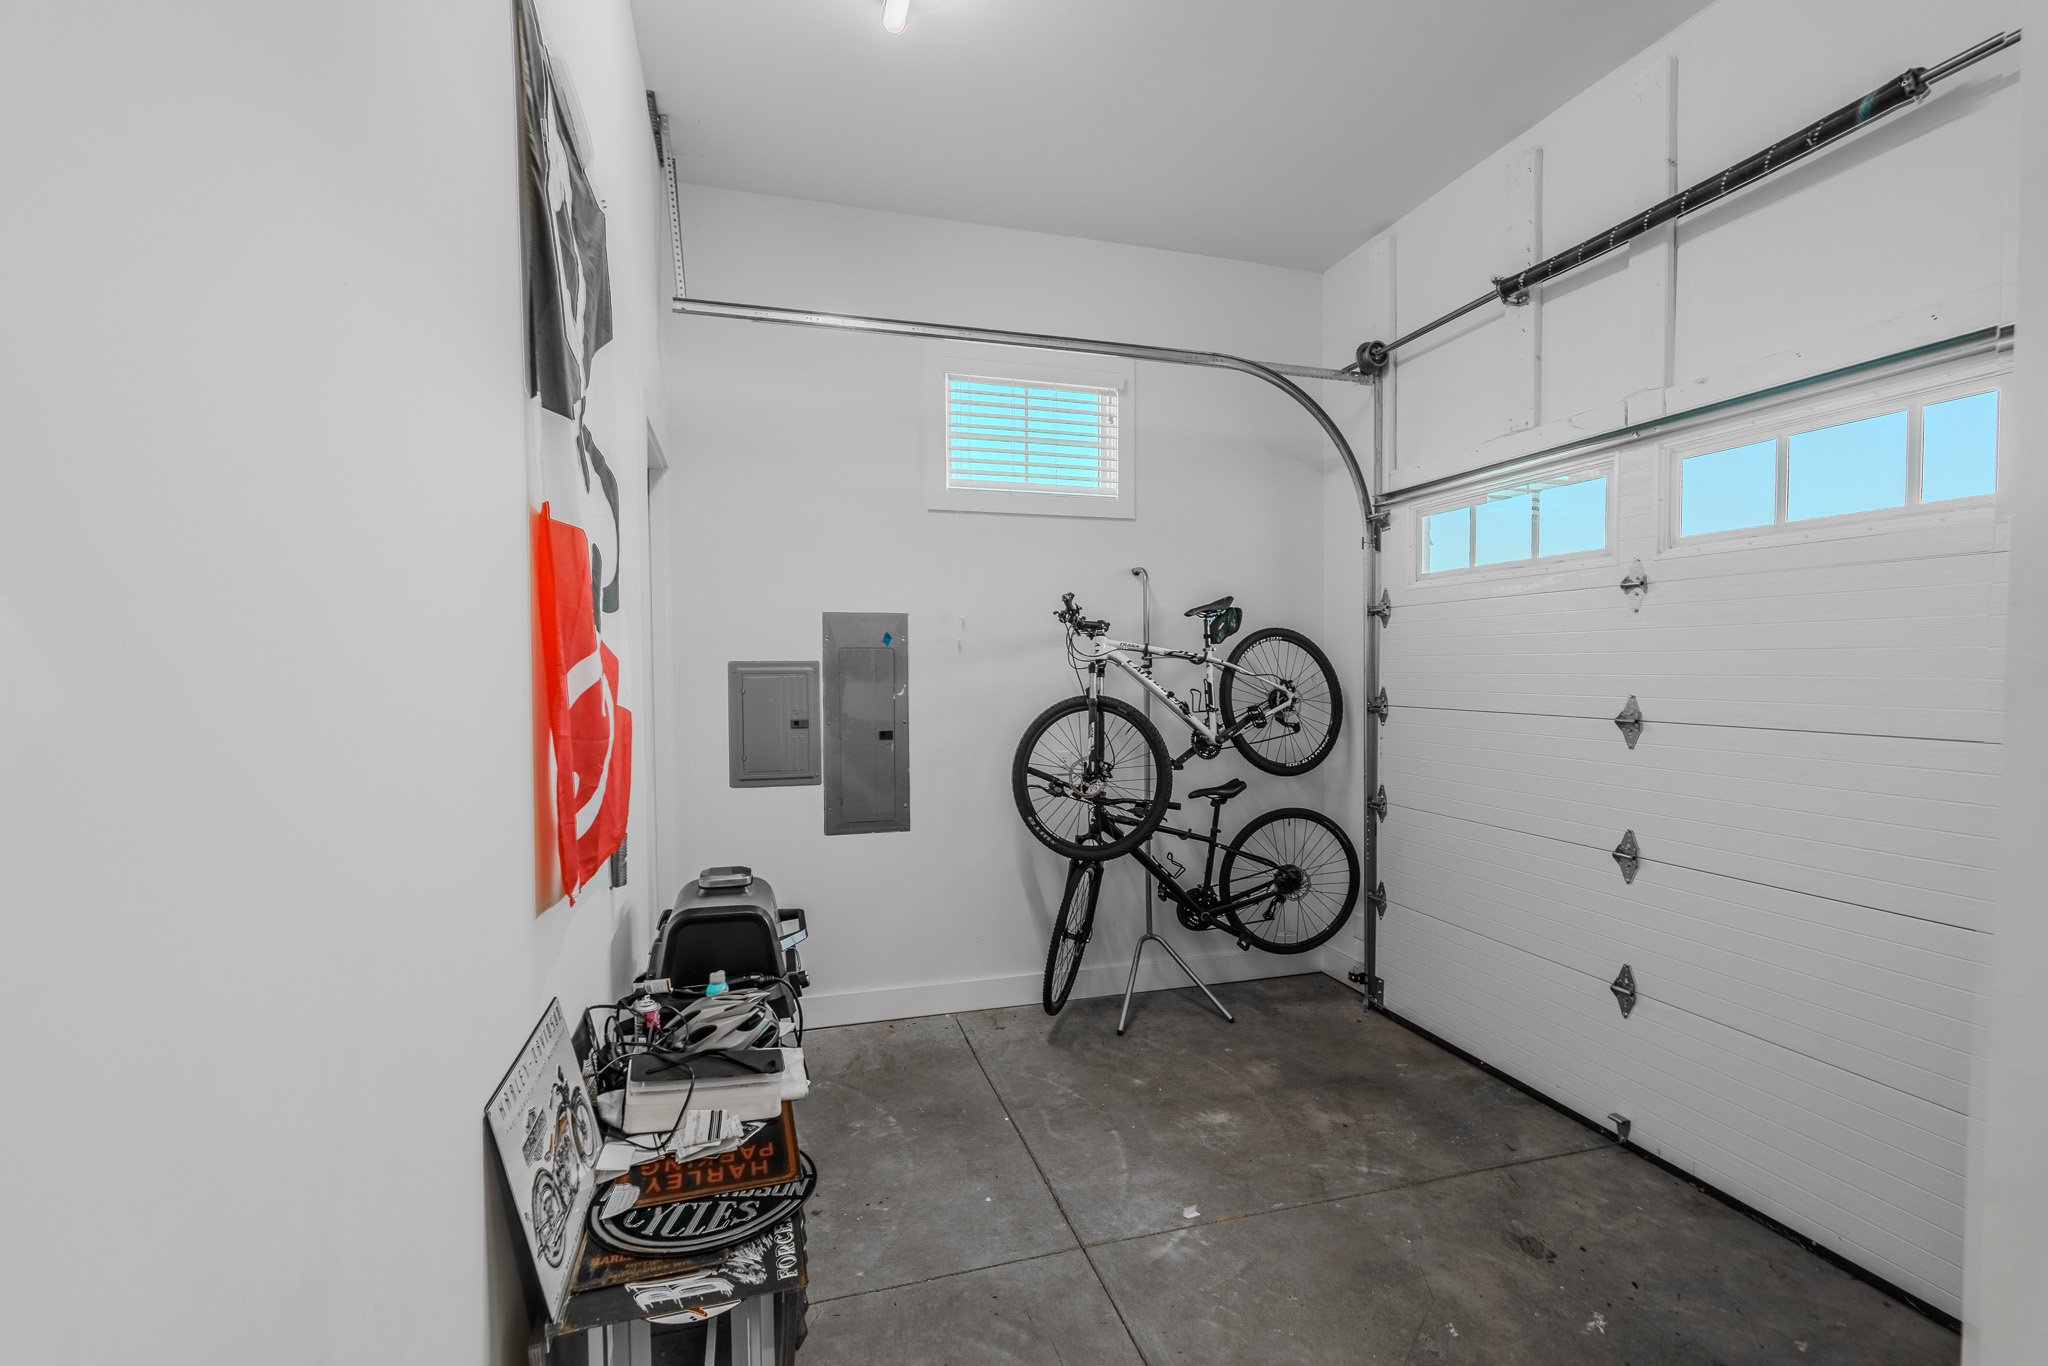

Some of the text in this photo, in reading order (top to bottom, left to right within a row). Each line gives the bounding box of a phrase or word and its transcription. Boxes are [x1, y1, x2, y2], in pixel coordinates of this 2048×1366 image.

[645, 1159, 769, 1195] HARLEY
[623, 1200, 760, 1238] CYCLES
[775, 1217, 799, 1281] FORCE
